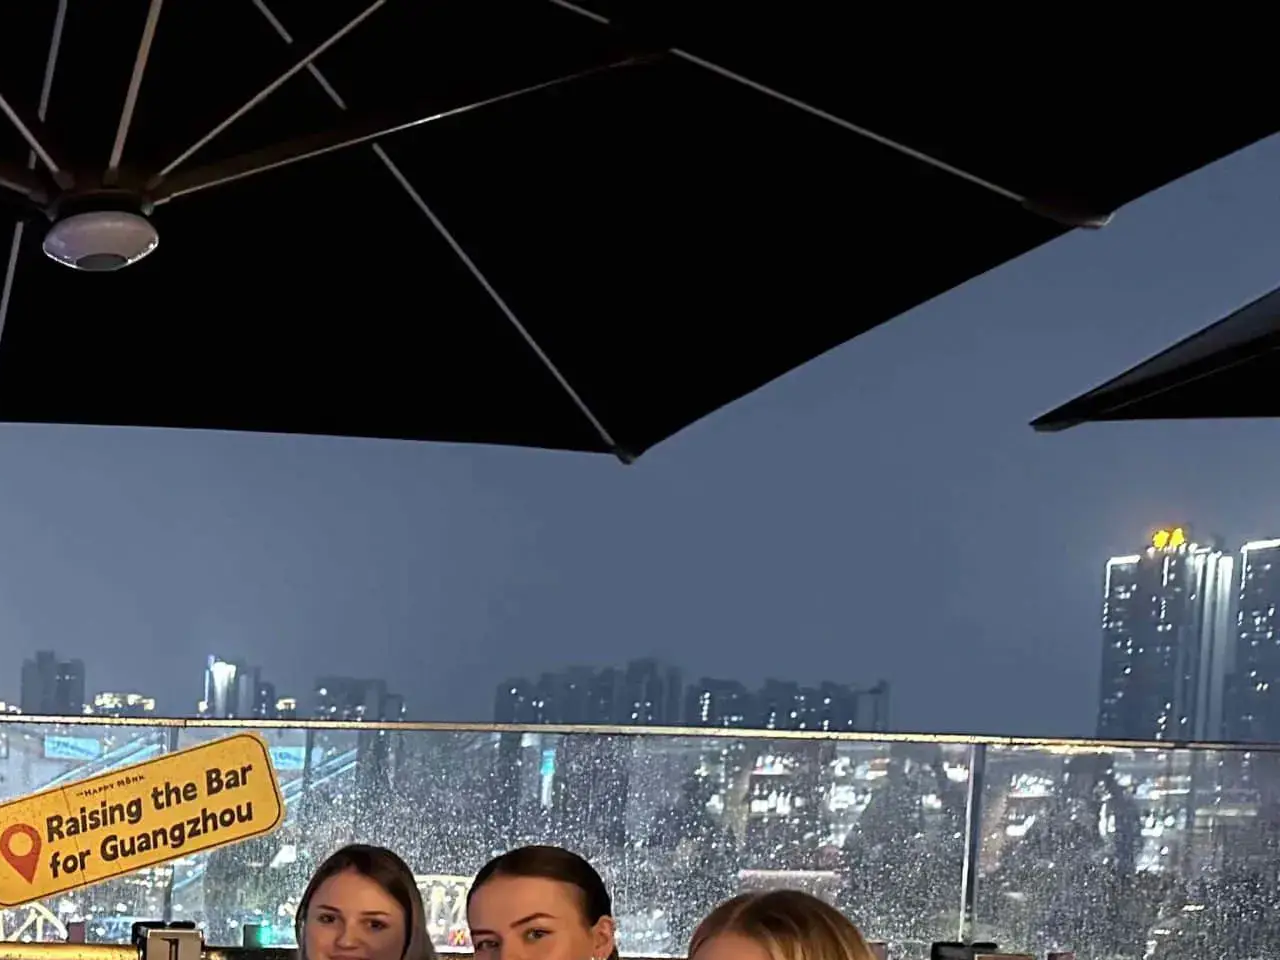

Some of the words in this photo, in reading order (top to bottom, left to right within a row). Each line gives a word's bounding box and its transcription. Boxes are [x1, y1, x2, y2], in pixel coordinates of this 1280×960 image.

[45, 797, 143, 843] Raising
[150, 781, 198, 811] the
[205, 763, 254, 797] Bar
[83, 783, 114, 797] HAPPY
[49, 849, 92, 879] for
[99, 801, 254, 862] Guangzhou
